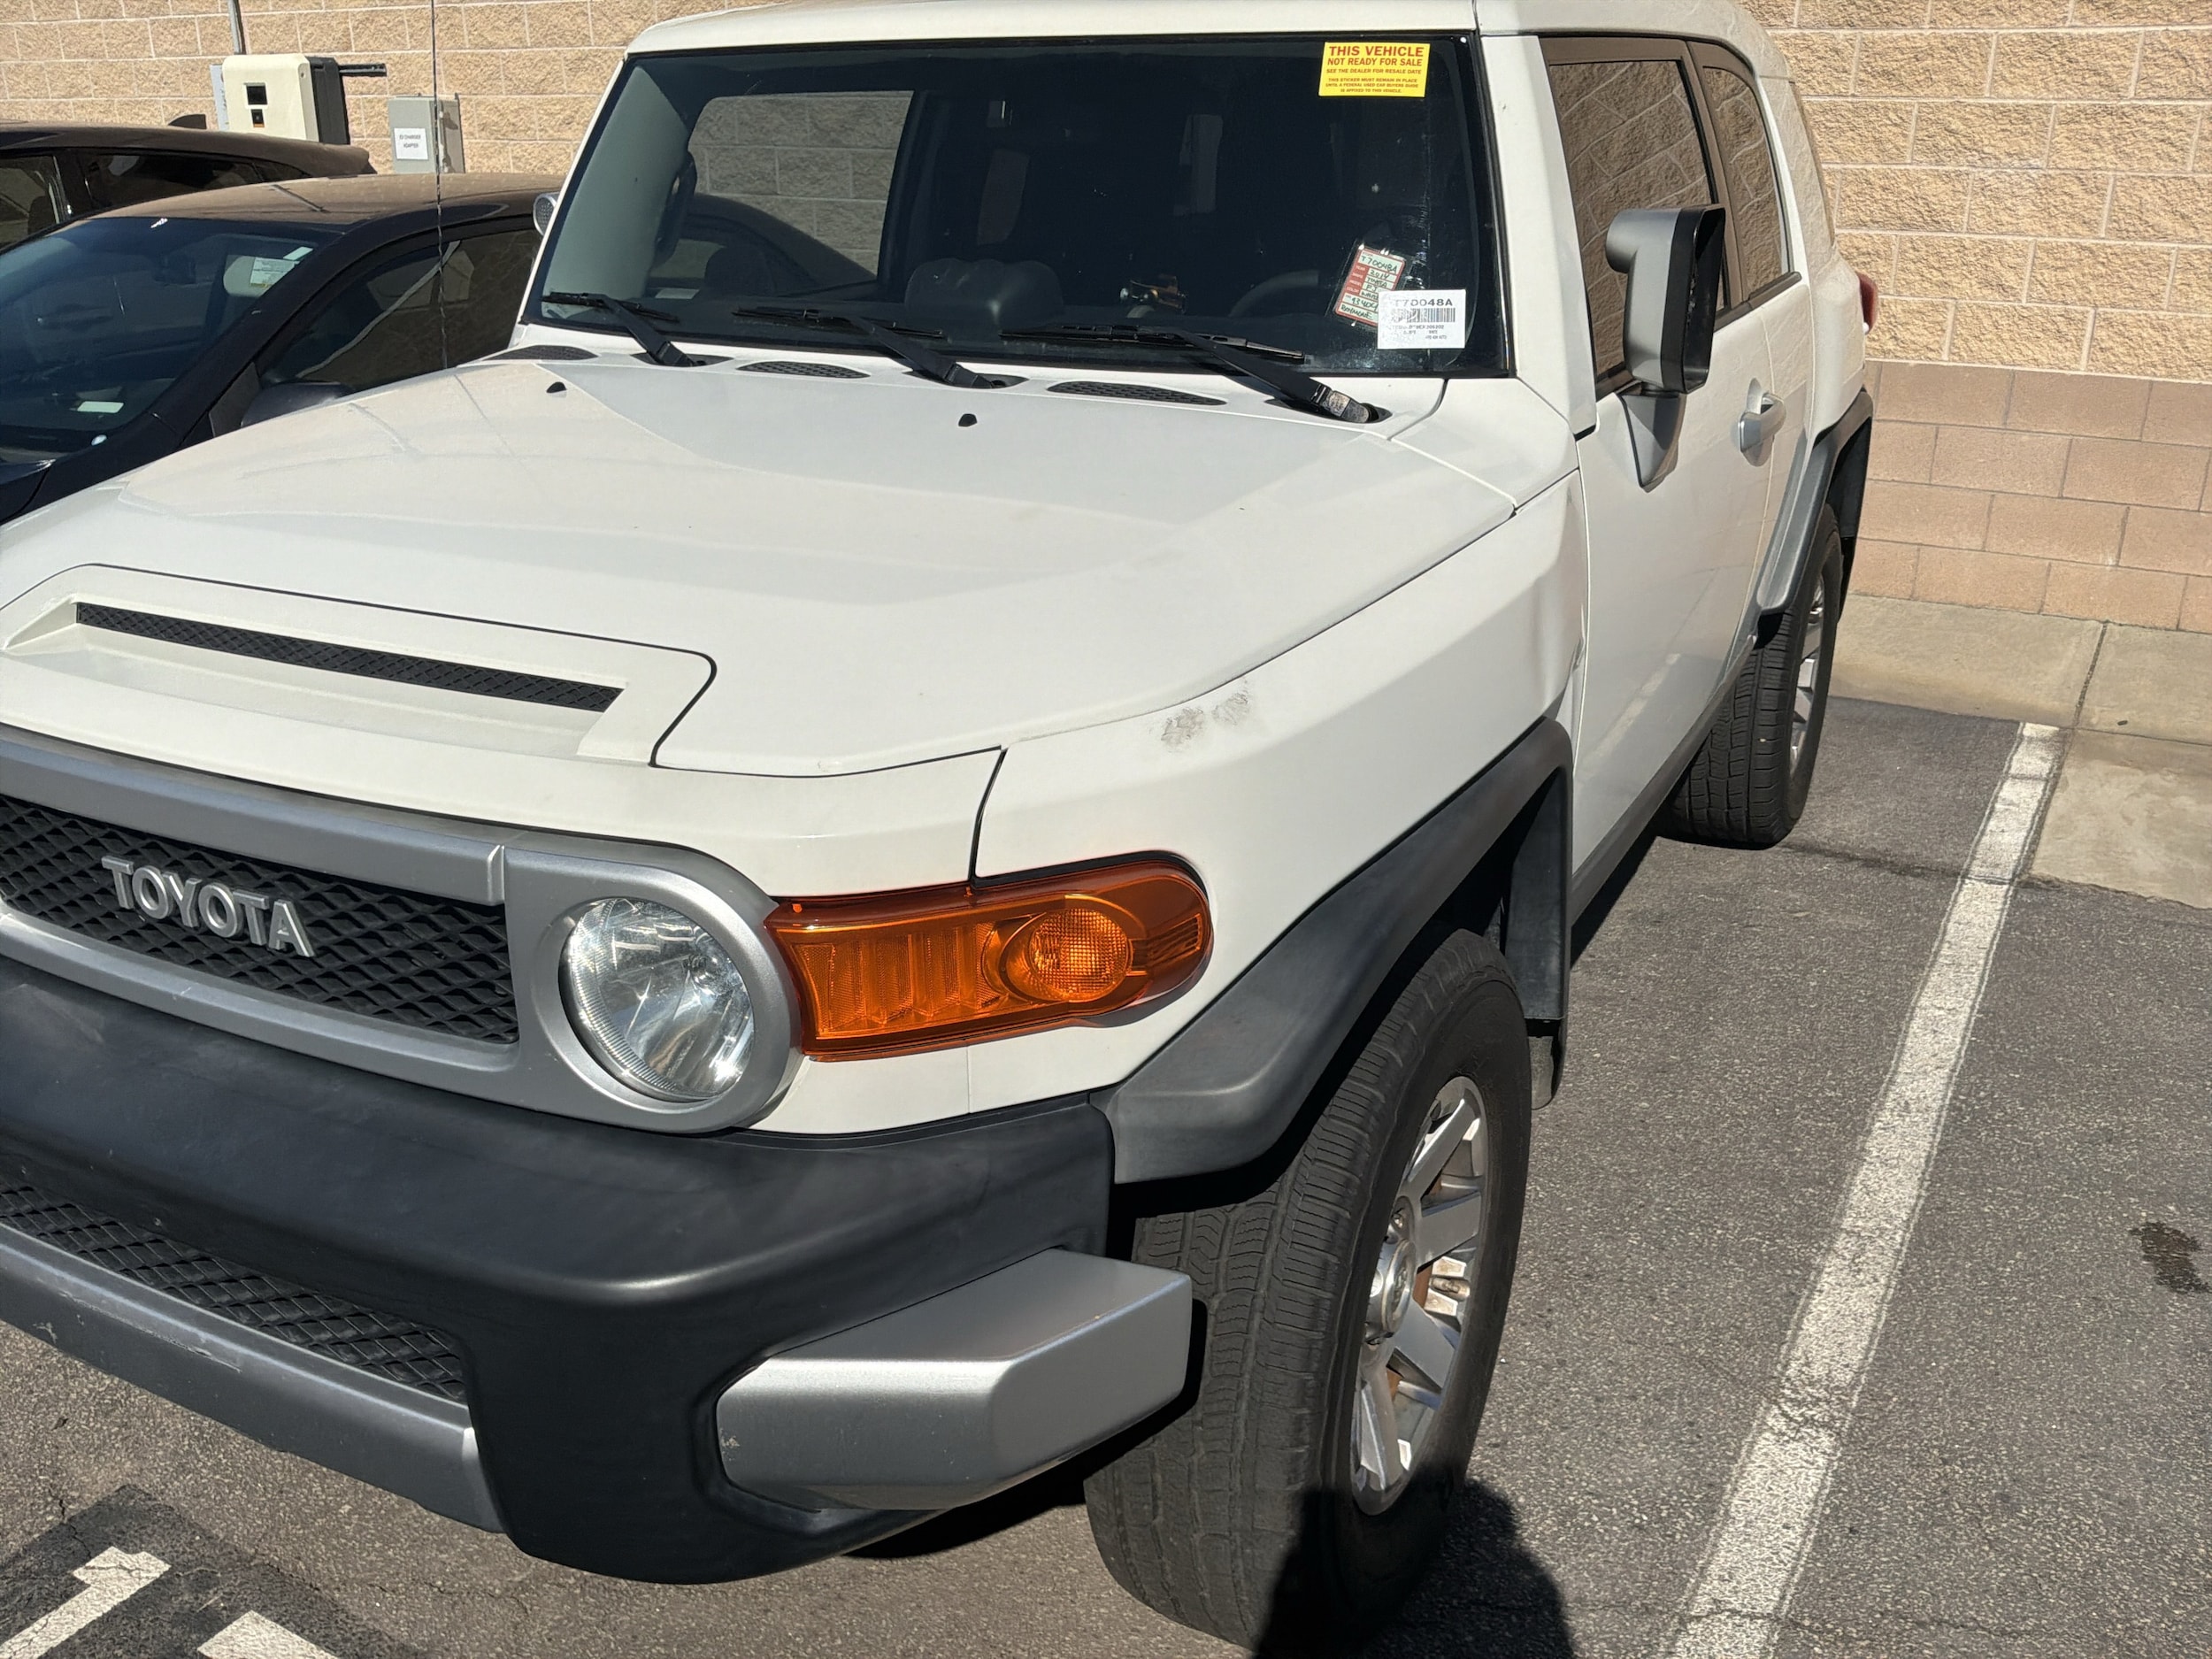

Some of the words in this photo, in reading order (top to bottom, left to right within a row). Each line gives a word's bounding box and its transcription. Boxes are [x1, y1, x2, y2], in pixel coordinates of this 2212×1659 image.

[1329, 46, 1360, 57] THIS
[1365, 46, 1424, 57] VEHICLE
[1327, 58, 1345, 66] NOT
[1348, 58, 1377, 66] READY
[1379, 58, 1398, 66] FOR
[1400, 58, 1422, 66] SALE
[101, 856, 315, 957] TOYOTA
